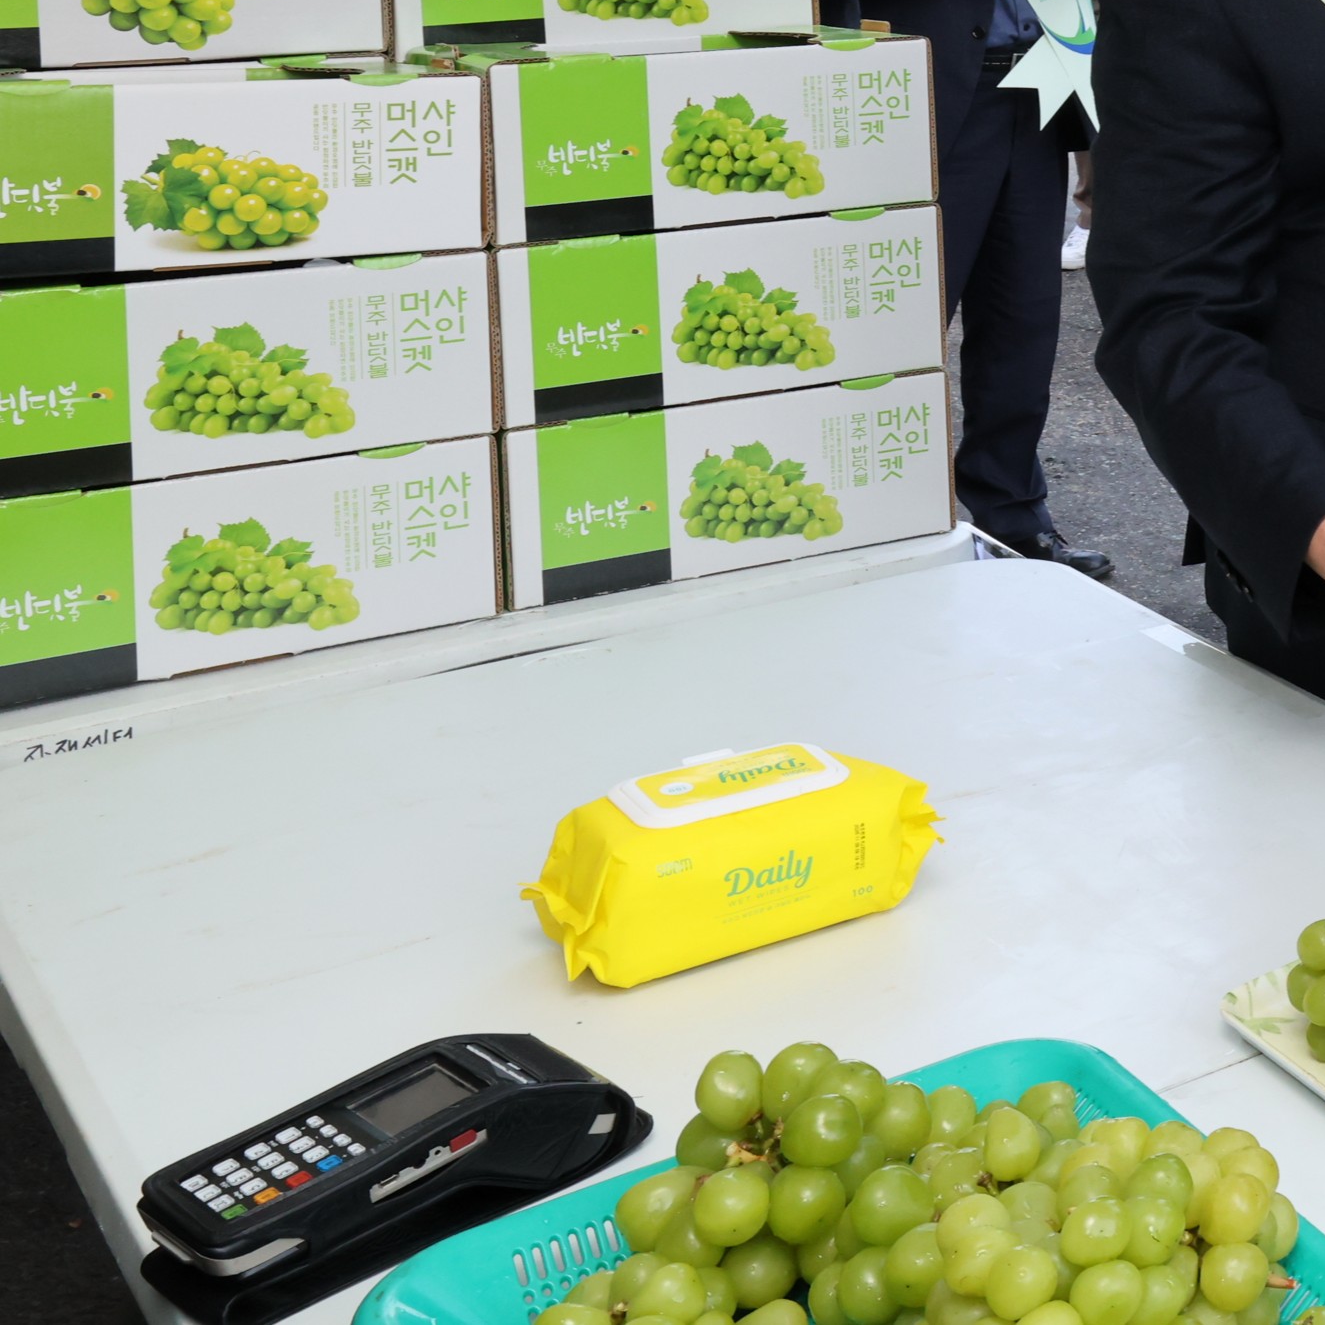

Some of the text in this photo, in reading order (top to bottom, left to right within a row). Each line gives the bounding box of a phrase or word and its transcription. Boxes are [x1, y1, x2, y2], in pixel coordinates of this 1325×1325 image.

[831, 73, 851, 149] 무주 반딧불
[885, 67, 912, 119] 샤인
[351, 102, 374, 188] 무주 반딧불
[386, 100, 419, 185] 머스캣
[422, 99, 456, 157] 샤인
[842, 244, 861, 319] 무주 반딧불
[896, 236, 922, 288] 샤인
[365, 295, 389, 379] 무주 반딧불
[434, 286, 469, 344] 샤인
[850, 413, 870, 488] 무주 반딧불
[904, 402, 931, 454] 샤인
[369, 483, 394, 569] 무주 반딧불
[439, 470, 471, 530] 샤인
[717, 758, 805, 784] Daily
[723, 849, 814, 897] Daily
